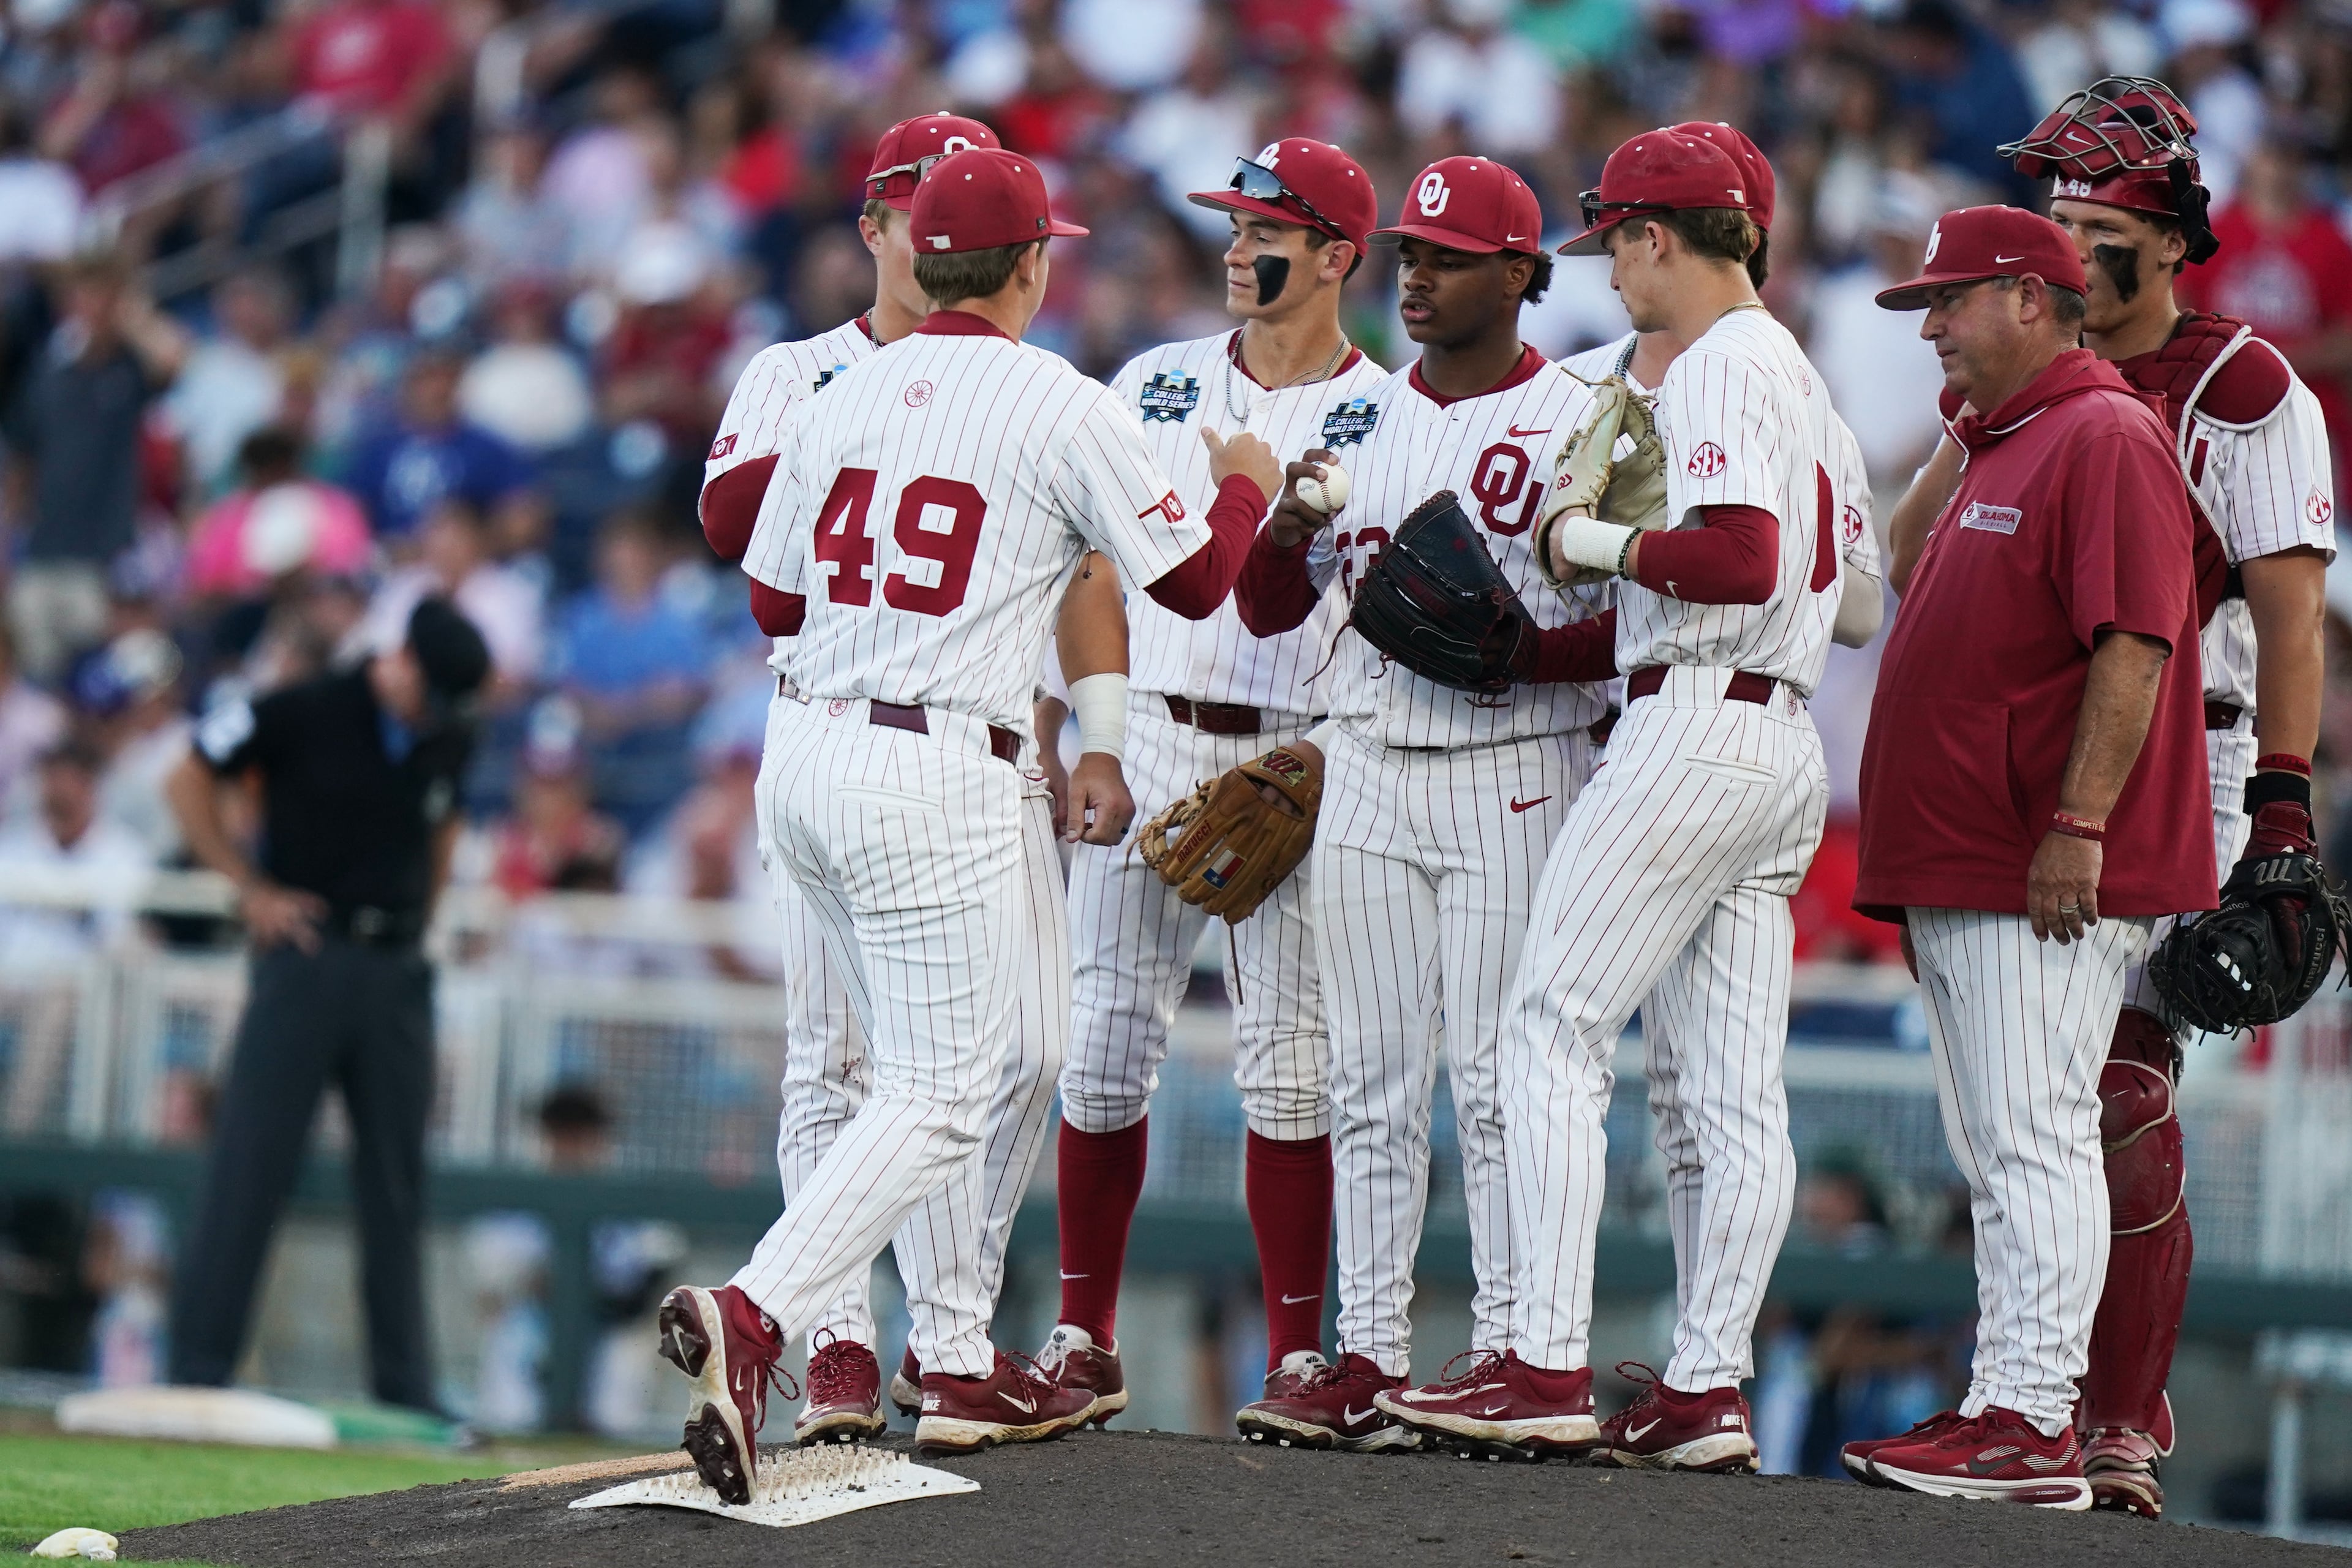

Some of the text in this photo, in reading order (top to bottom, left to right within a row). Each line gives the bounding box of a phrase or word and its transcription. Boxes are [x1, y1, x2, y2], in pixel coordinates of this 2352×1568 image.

[1417, 172, 1451, 217] OU
[1153, 390, 1188, 402] COLLEGE
[1141, 398, 1196, 409] WORLD SERIES
[1335, 417, 1366, 426] COLLEGE
[1323, 424, 1348, 435] WORLD
[1688, 442, 1725, 477] SEC
[1470, 442, 1545, 538] OU
[814, 467, 988, 617] 49
[2073, 819, 2098, 831] COMPETE
[1177, 818, 1212, 864] marucci
[2303, 927, 2326, 989] marucci
[1053, 1330, 1067, 1343] NIKE
[921, 1400, 941, 1411] NIKE
[1721, 1414, 1741, 1427] NIKE
